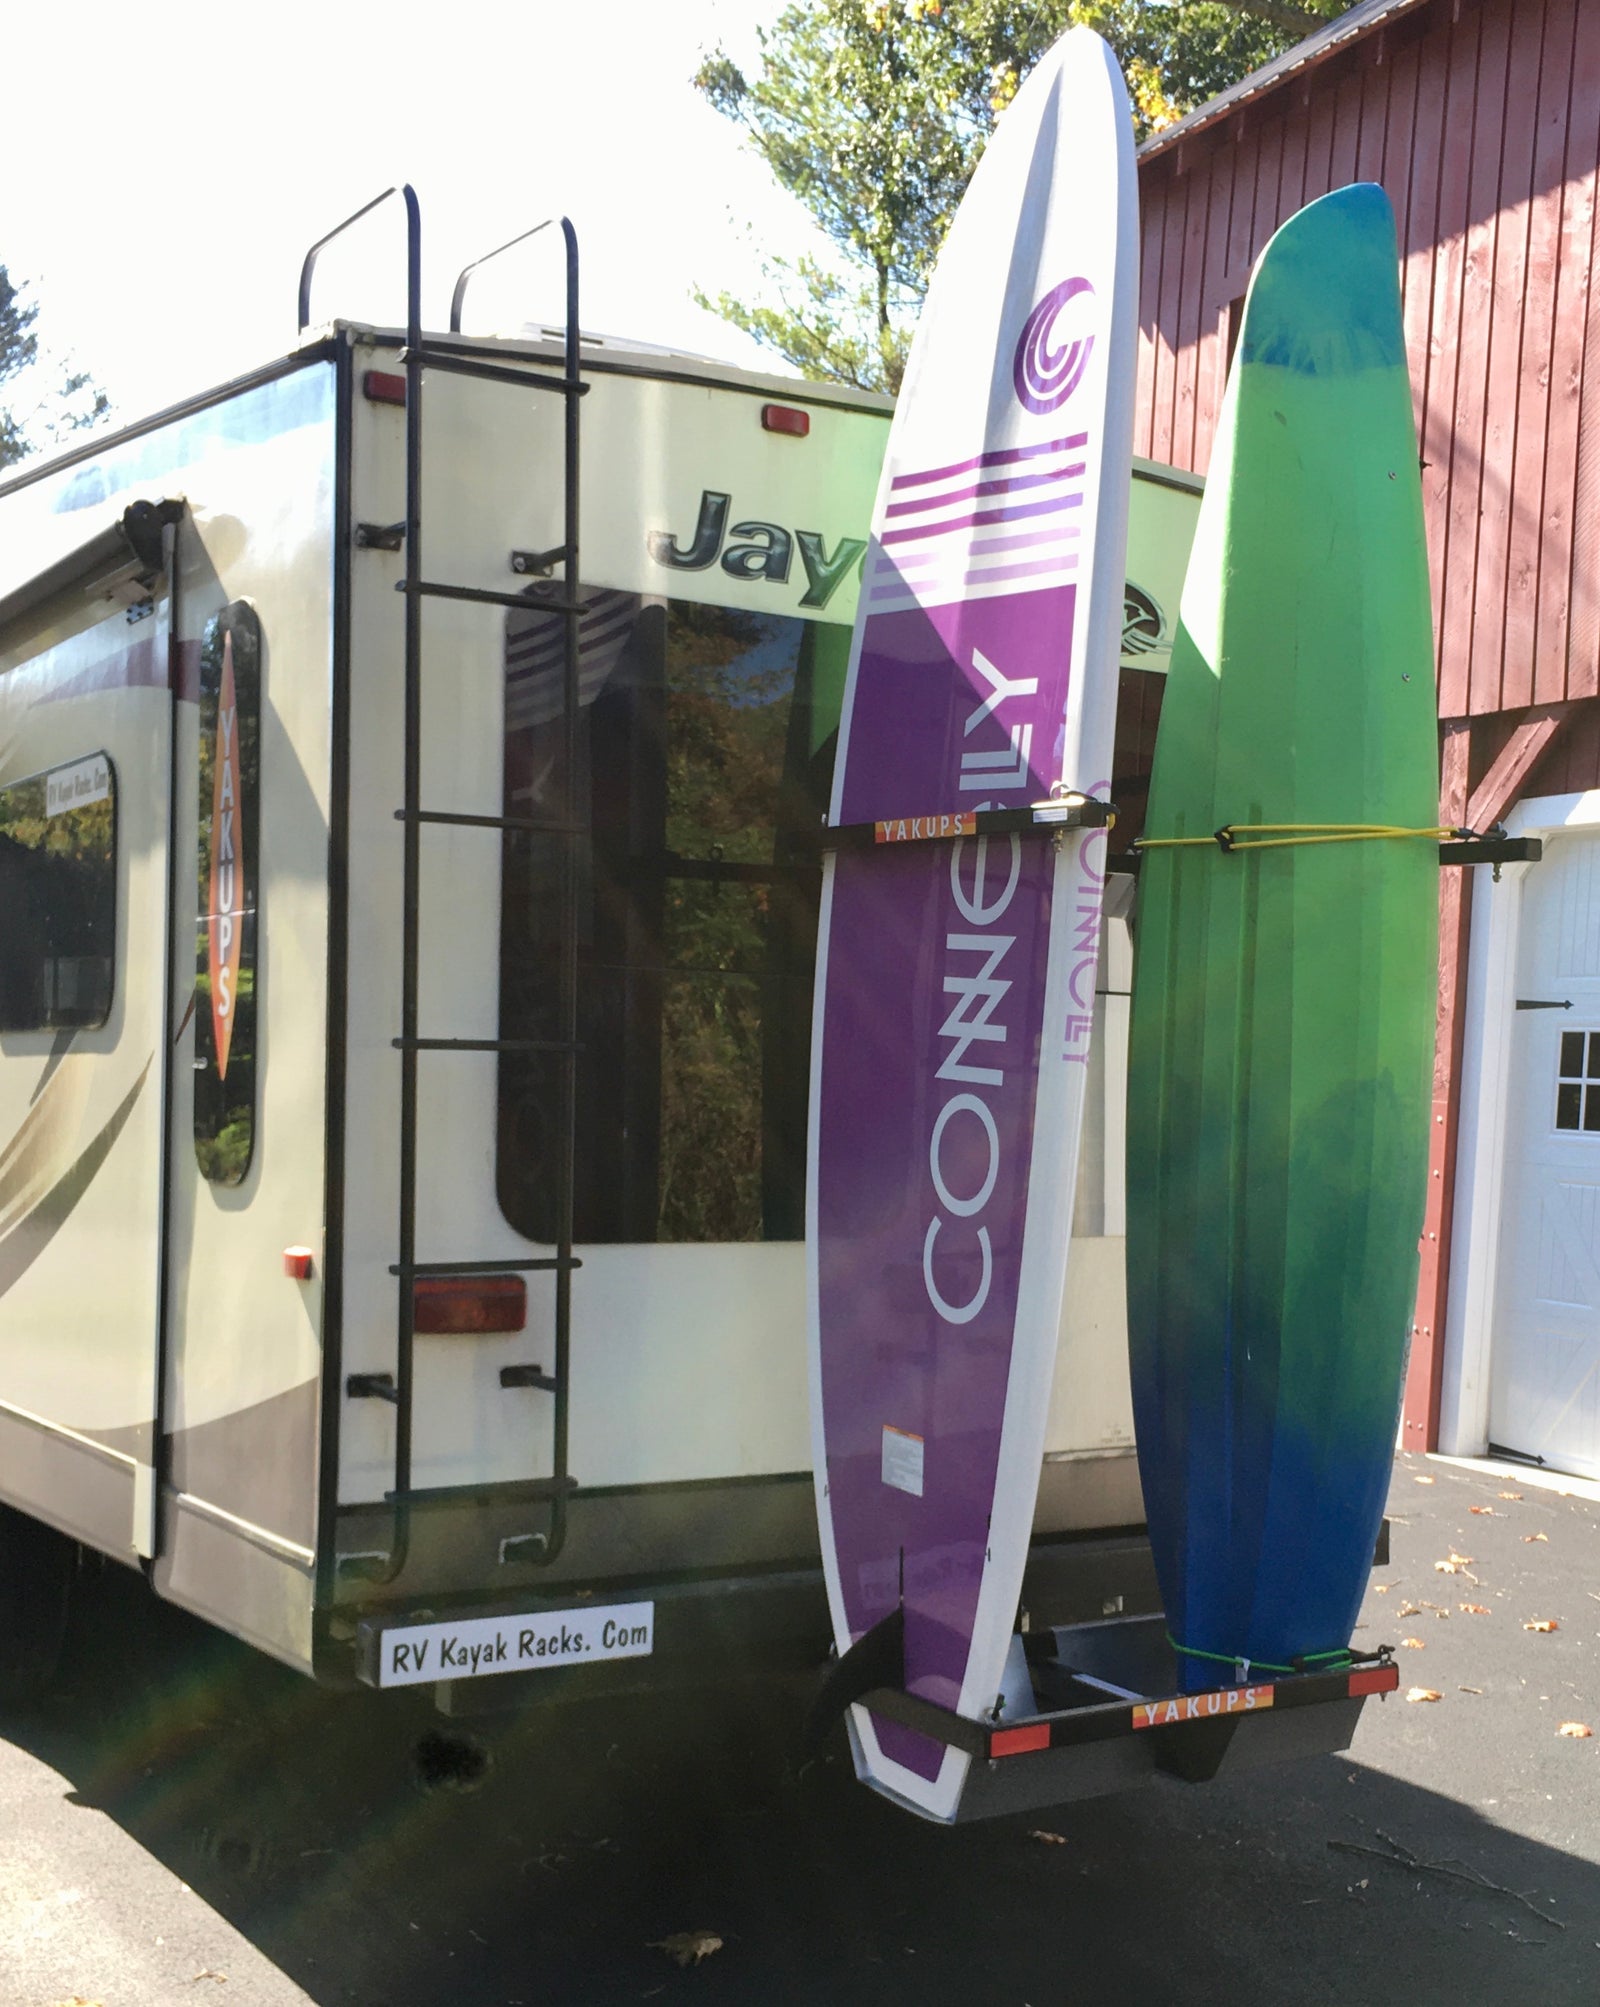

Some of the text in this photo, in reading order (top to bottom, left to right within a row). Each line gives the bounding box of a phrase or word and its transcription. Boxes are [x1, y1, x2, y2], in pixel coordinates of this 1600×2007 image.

[647, 489, 868, 611] Jay
[218, 705, 235, 1017] YAKUPS
[882, 814, 963, 842] YAKUPS
[923, 647, 1039, 1325] CONNELLY
[393, 1619, 648, 1674] RV Kayak Racks. Com
[1145, 1687, 1257, 1726] YAKUPS
